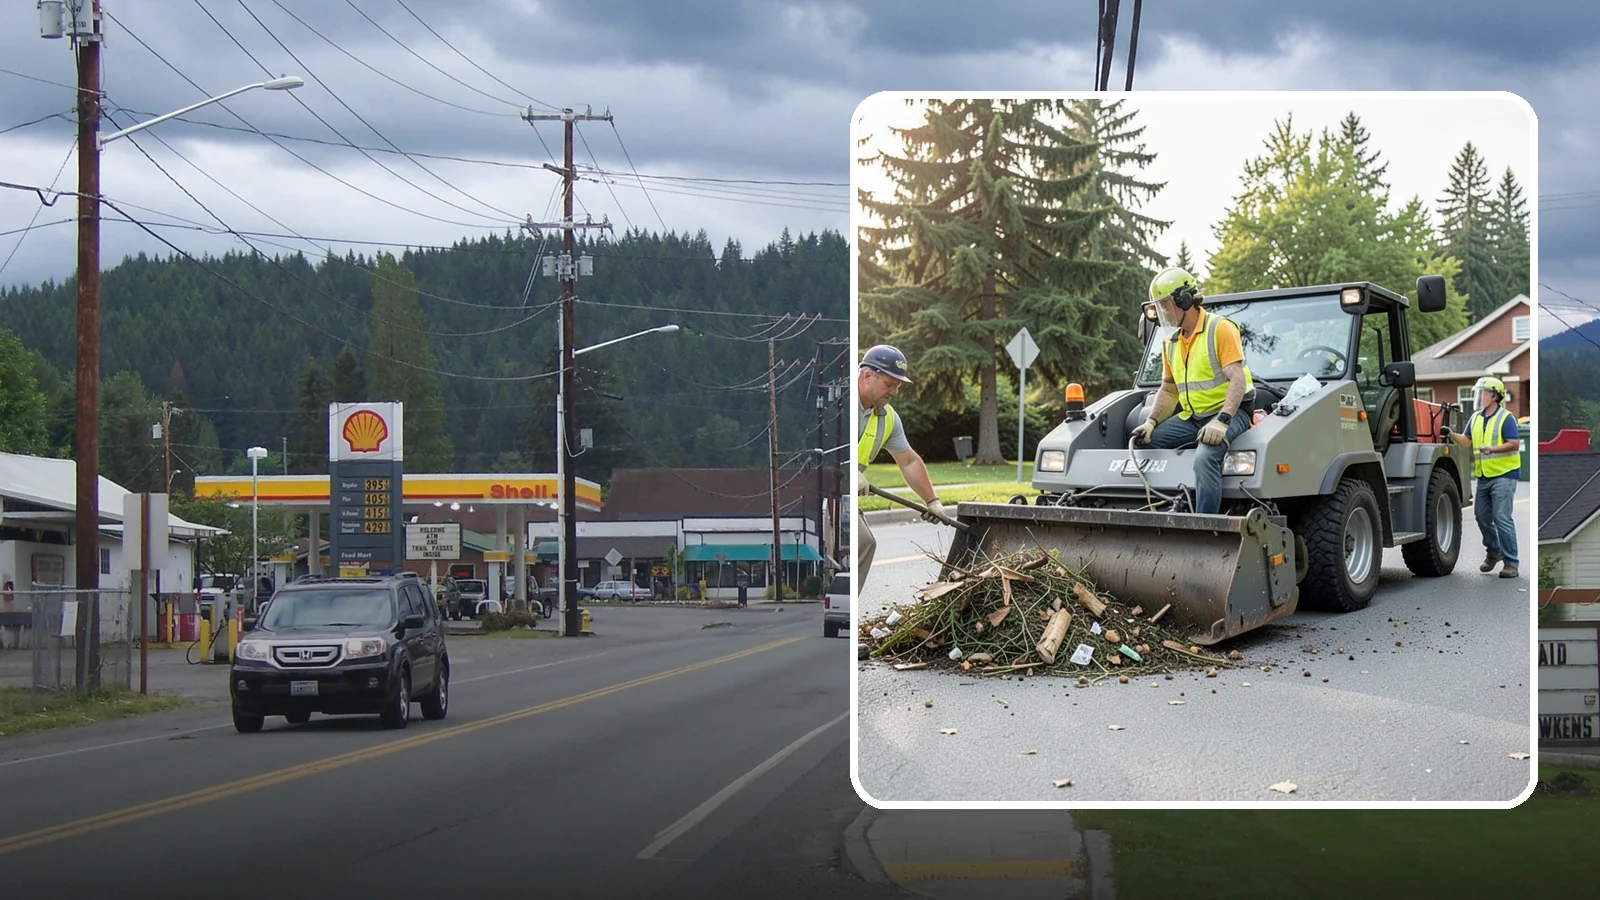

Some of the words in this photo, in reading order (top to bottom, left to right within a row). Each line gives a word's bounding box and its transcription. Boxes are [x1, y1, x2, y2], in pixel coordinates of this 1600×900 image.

[366, 480, 384, 490] 395
[490, 484, 547, 499] Shell
[366, 494, 384, 504] 405
[366, 508, 383, 518] 415
[366, 522, 384, 532] 429
